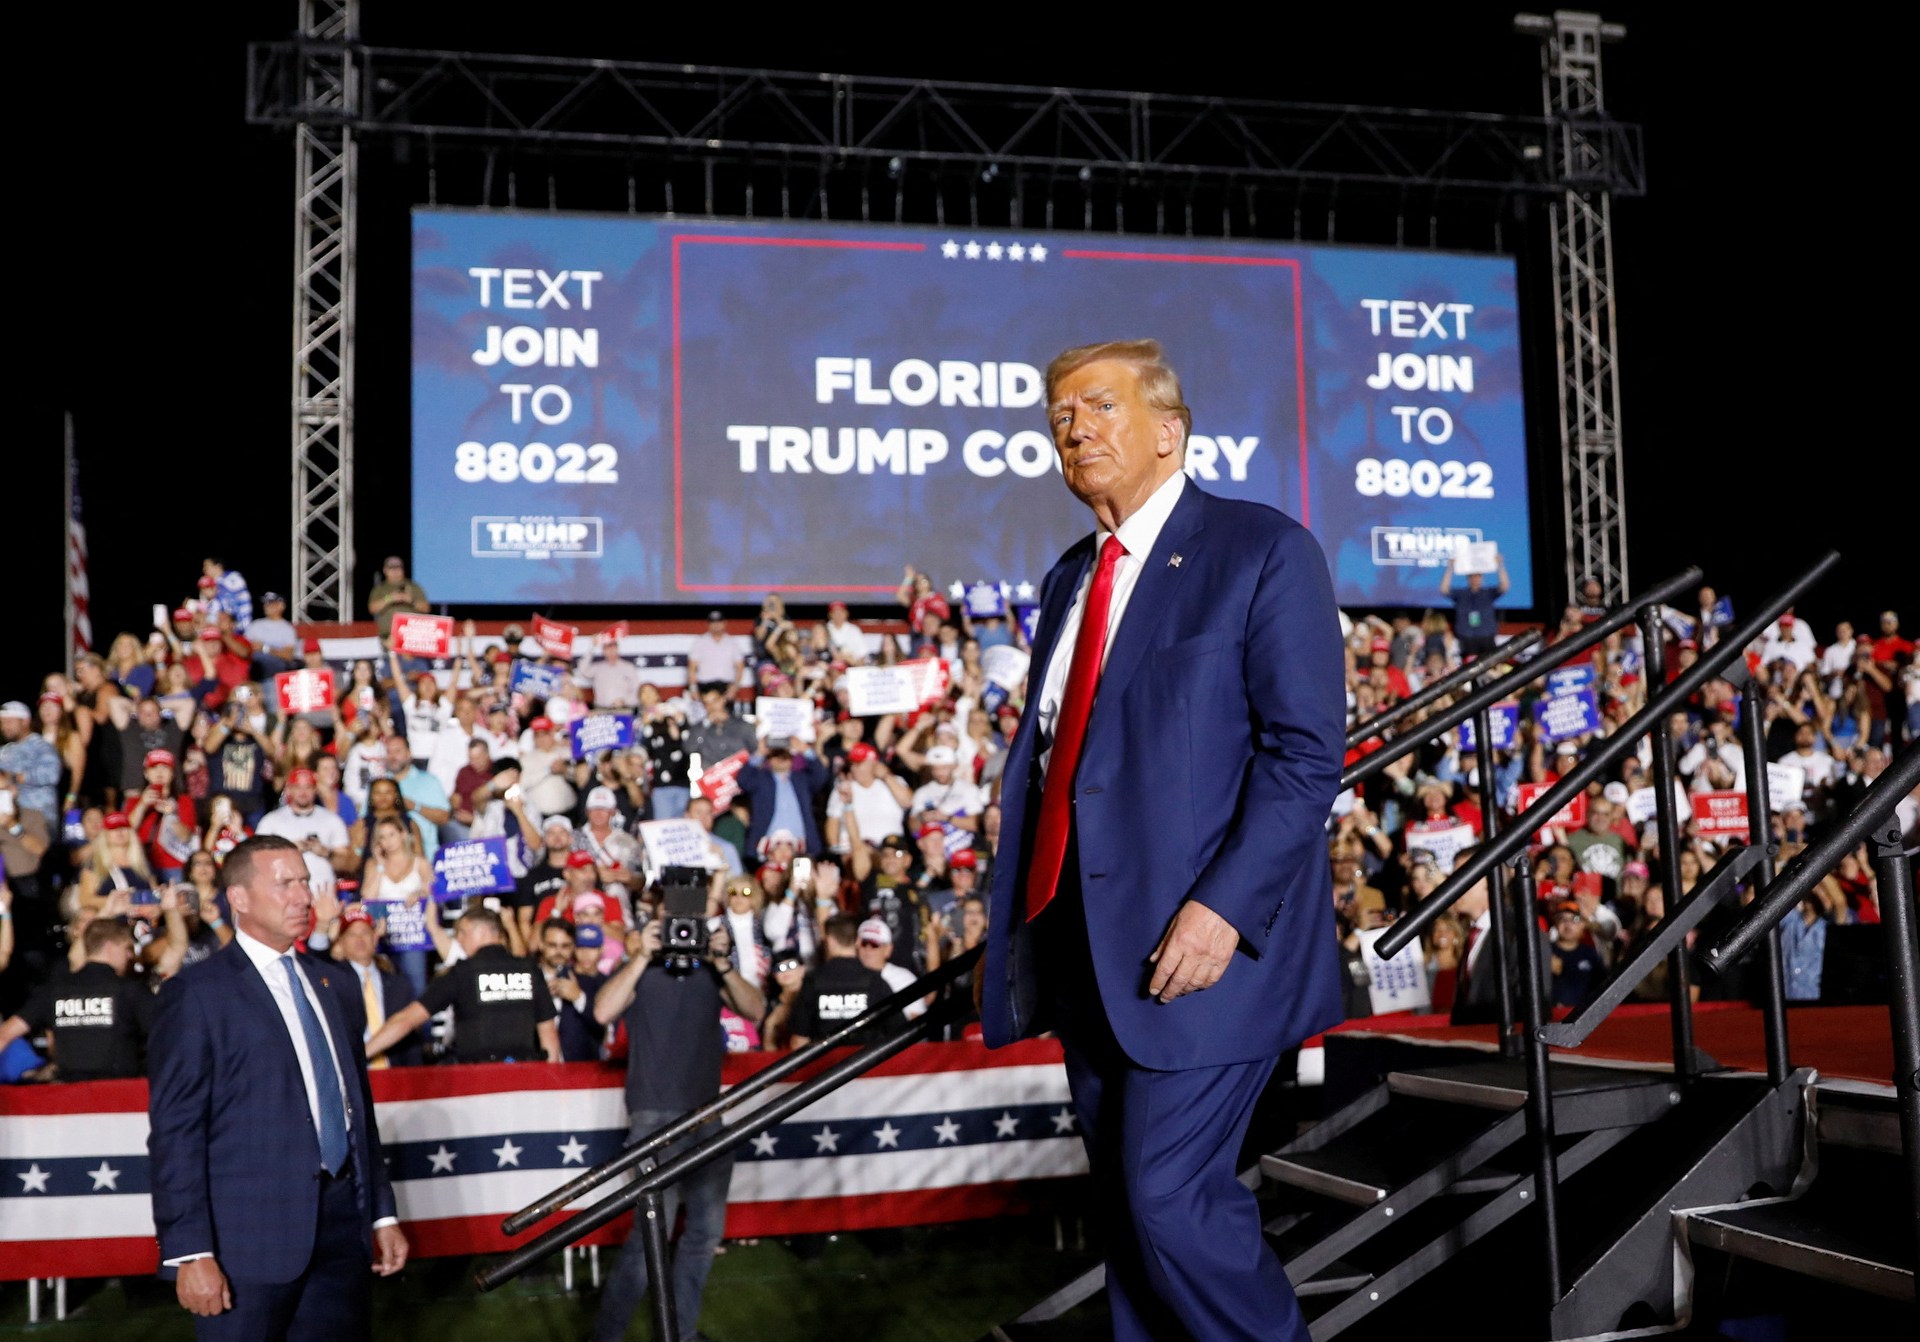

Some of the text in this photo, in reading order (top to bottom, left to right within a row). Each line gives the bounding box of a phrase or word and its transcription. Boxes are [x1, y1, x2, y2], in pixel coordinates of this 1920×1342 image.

[469, 268, 603, 310] TEXT
[1361, 299, 1474, 340] TEXT
[471, 326, 599, 368] JOIN
[816, 357, 1047, 409] FLORID
[1366, 353, 1474, 393] JOIN
[500, 384, 573, 426] TO
[1391, 406, 1454, 445] TO
[455, 442, 619, 484] 88022
[727, 425, 1260, 482] TRUMP CORY
[1355, 458, 1495, 499] 88022
[486, 523, 588, 543] TRUMP
[435, 852, 500, 874] AMERICA
[444, 842, 486, 860] MAKE
[445, 864, 492, 882] GREAT
[447, 875, 498, 893] AGAIN!
[479, 973, 532, 991] POLICE
[55, 997, 112, 1016] POLICE
[819, 994, 868, 1010] POLICE
